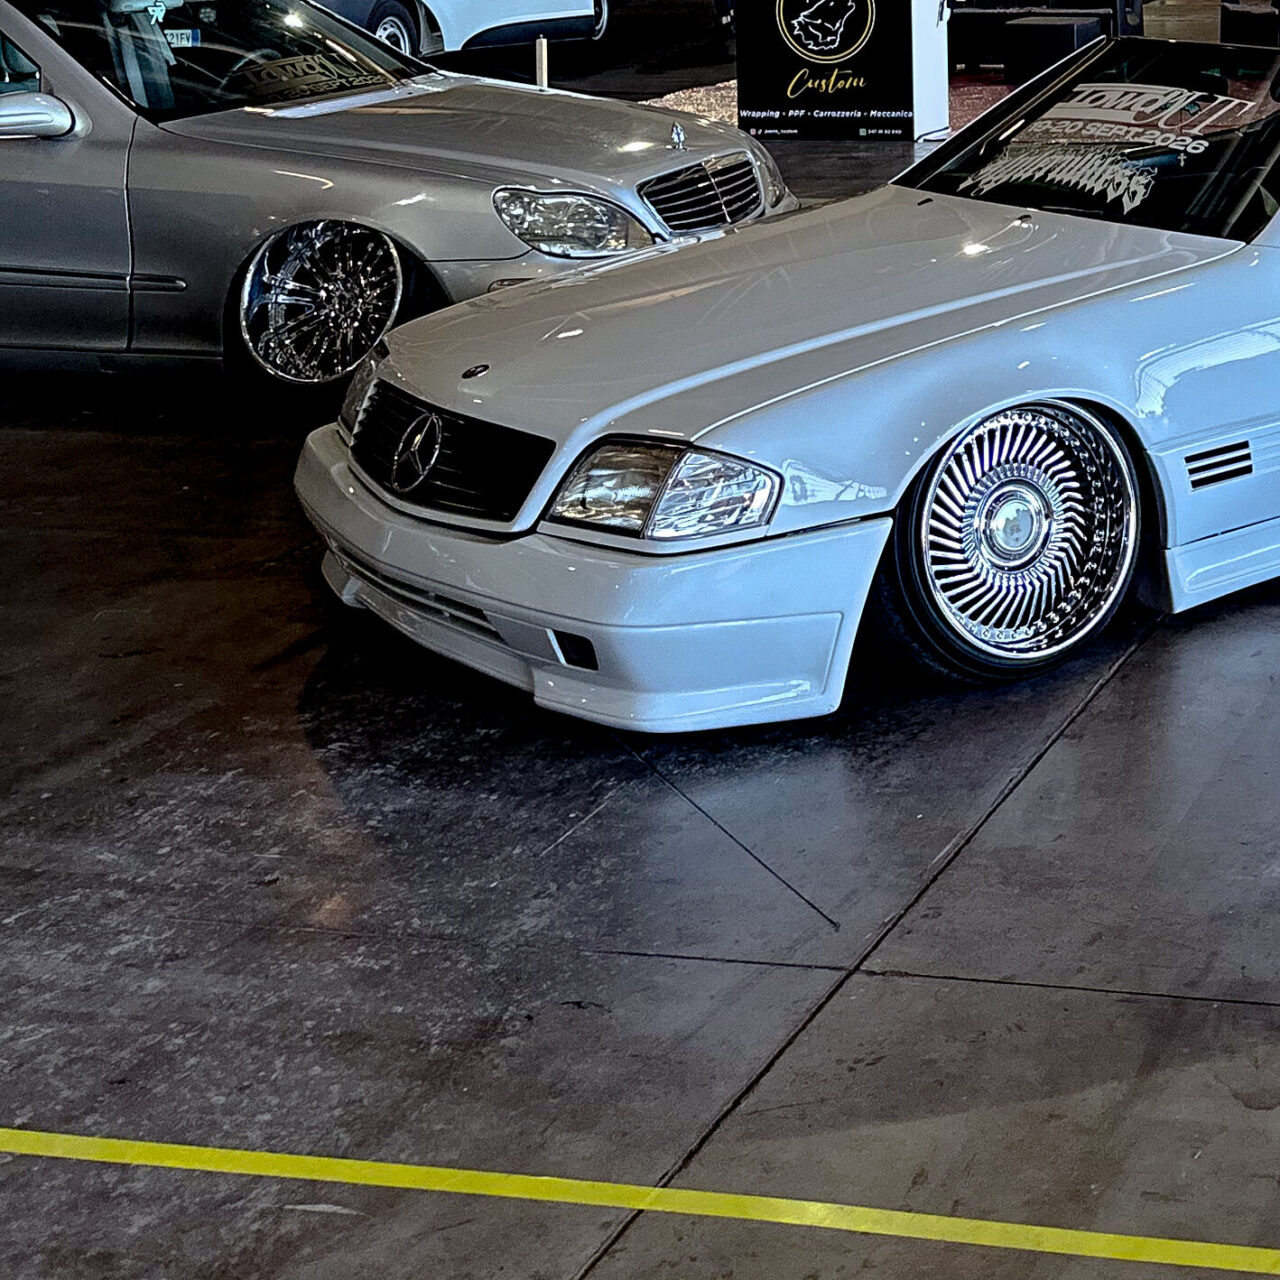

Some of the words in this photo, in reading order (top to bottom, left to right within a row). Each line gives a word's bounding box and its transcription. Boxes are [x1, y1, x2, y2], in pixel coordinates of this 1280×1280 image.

[787, 68, 867, 99] Custom
[740, 109, 780, 119] Wrapping
[813, 109, 861, 118] Carrozzeria
